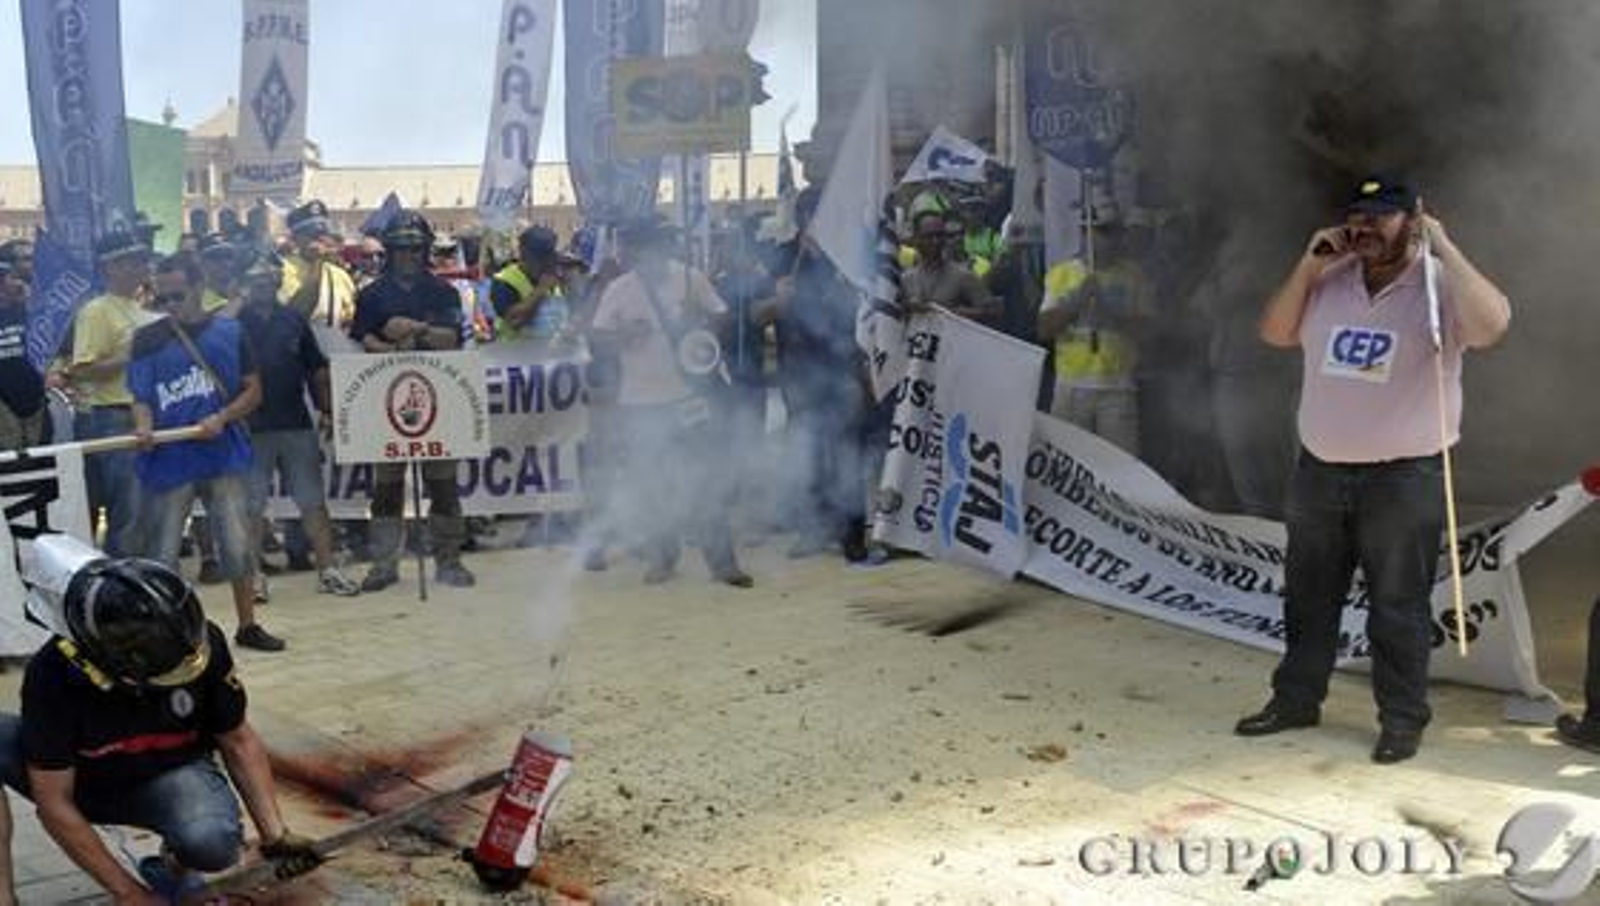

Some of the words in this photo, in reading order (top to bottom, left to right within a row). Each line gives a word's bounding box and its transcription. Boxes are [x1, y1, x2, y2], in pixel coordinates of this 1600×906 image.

[1332, 329, 1393, 367] CEP
[384, 441, 452, 458] S.P.B.
[953, 432, 1003, 555] STAJ
[1117, 571, 1152, 596] A
